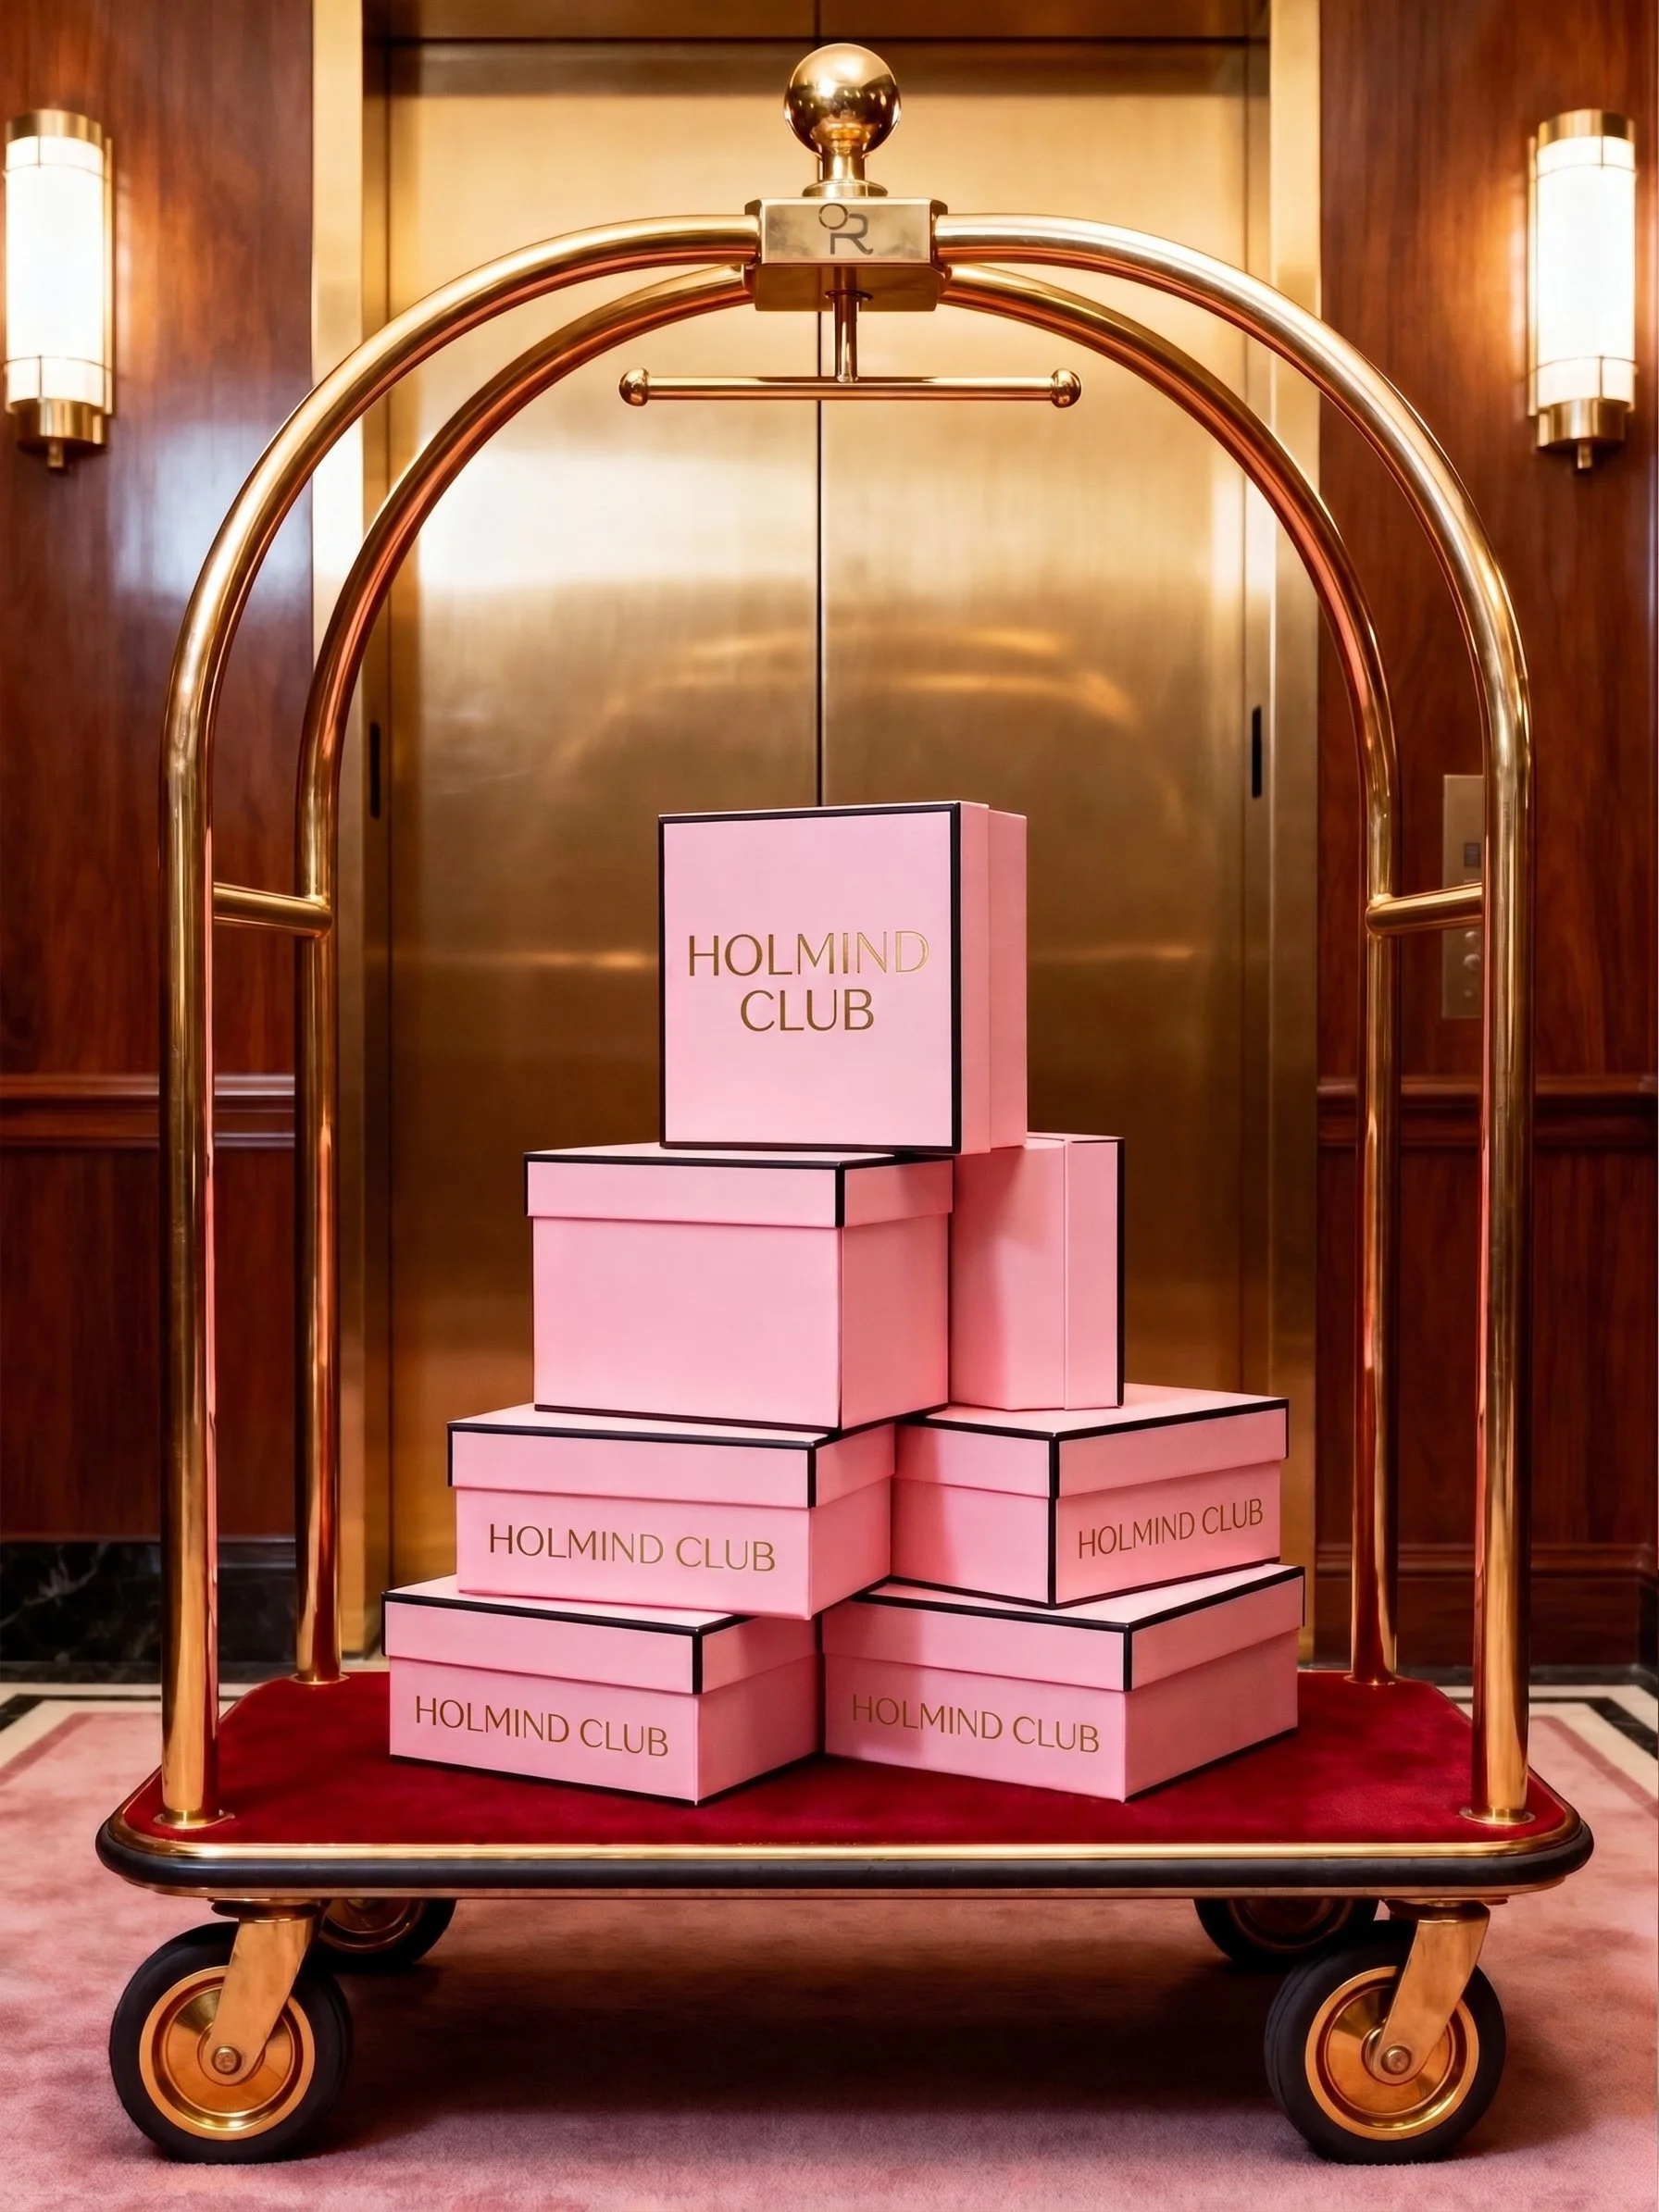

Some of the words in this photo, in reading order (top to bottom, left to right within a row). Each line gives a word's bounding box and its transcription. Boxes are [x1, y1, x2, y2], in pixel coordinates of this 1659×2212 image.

[689, 930, 929, 976] HOLMIND
[740, 988, 874, 1032] CLUB
[490, 1523, 664, 1564] HOLMIND
[676, 1536, 776, 1572] CLUB
[1079, 1511, 1195, 1560] HOLMIND
[1202, 1497, 1264, 1535] CLUB
[416, 1696, 569, 1743] HOLMIND
[580, 1718, 668, 1757] CLUB
[853, 1694, 1003, 1739] HOLMIND
[1013, 1716, 1100, 1753] CLUB
